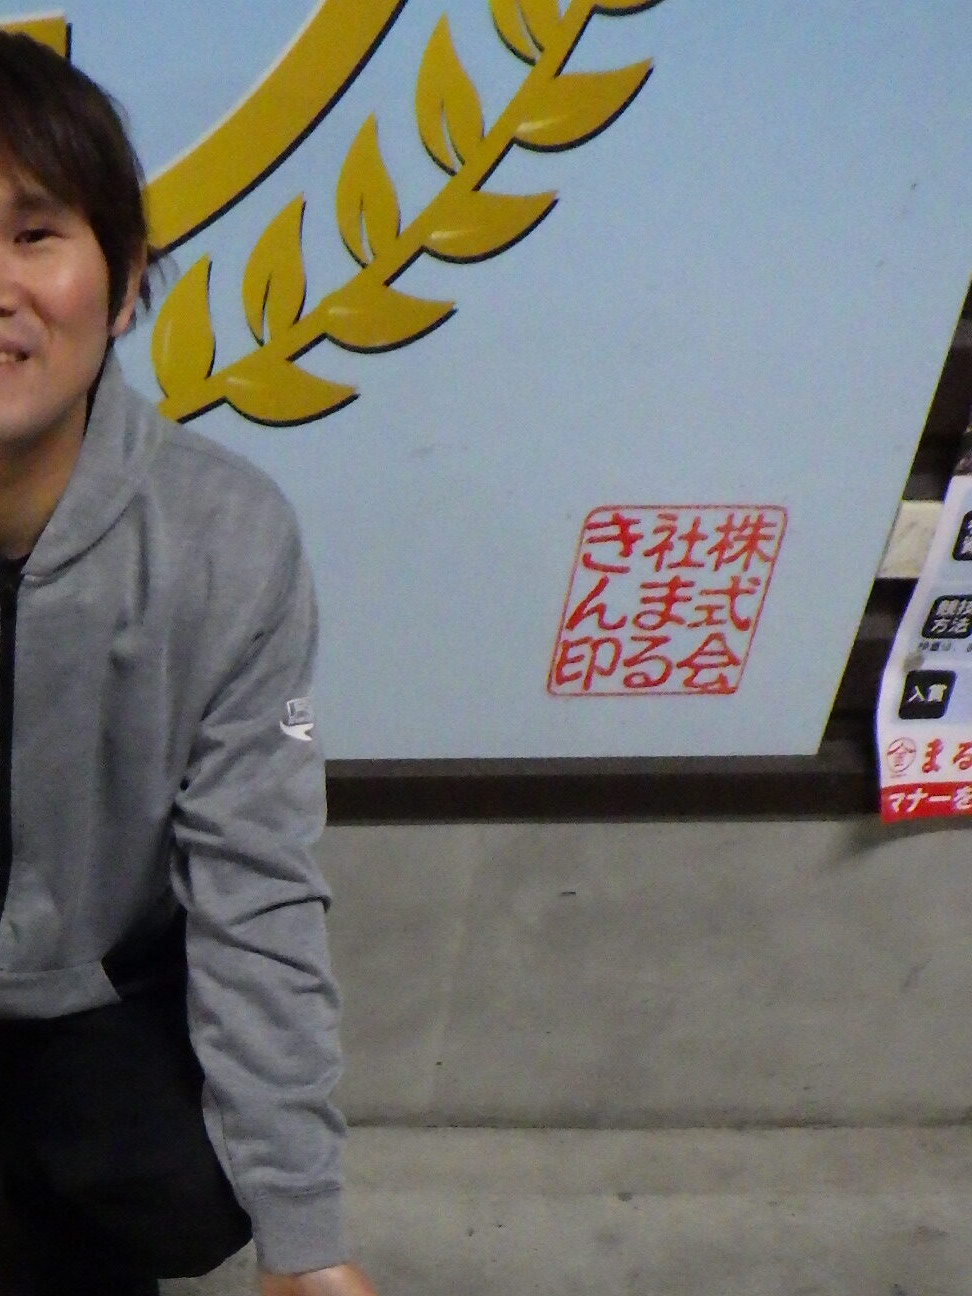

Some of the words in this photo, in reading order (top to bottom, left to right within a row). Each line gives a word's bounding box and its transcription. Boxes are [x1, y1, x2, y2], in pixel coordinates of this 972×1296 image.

[554, 513, 643, 690] きん印
[622, 513, 708, 688] 社まる
[677, 513, 777, 694] 株式会
